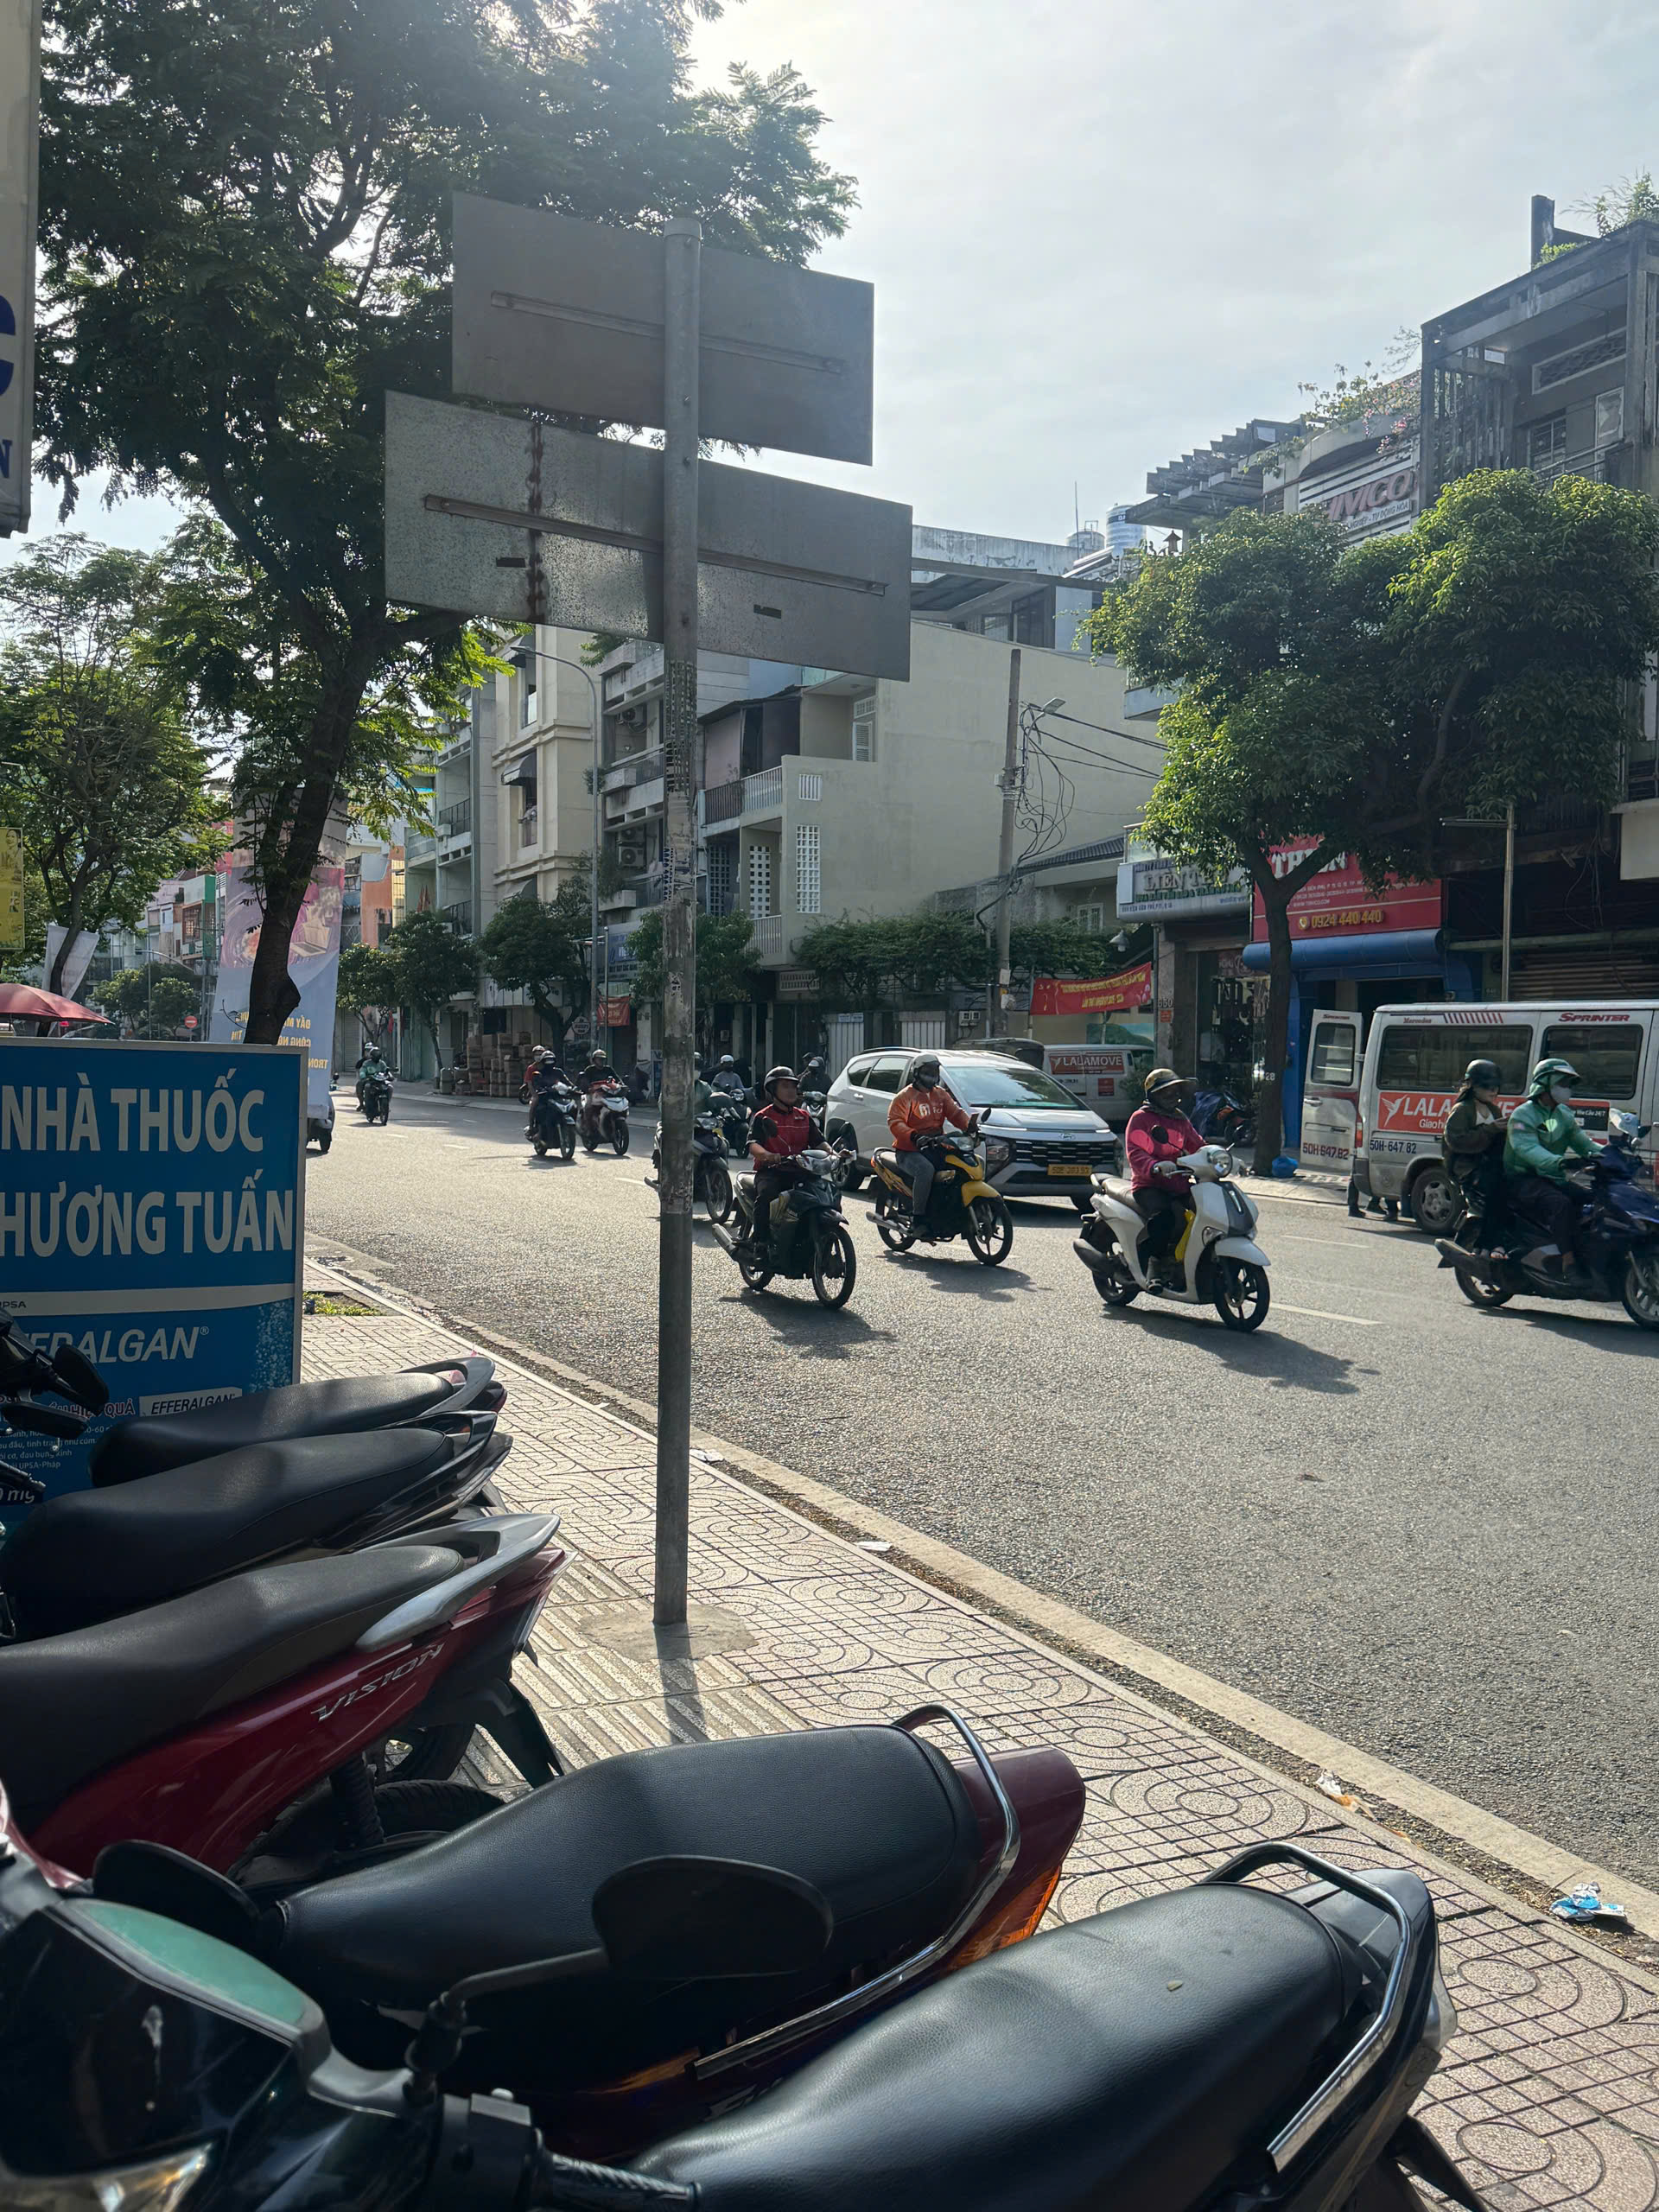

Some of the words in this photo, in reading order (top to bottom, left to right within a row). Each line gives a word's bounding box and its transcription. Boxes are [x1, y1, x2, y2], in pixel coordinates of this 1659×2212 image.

[1311, 915, 1336, 929] 0924
[1338, 912, 1359, 925] 440
[1361, 910, 1382, 924] 440
[1063, 1056, 1122, 1066] LALAMOVE
[1, 1072, 101, 1153] NHÀ
[111, 1068, 265, 1153] THUỐC
[175, 1168, 293, 1255] TUẤN
[0, 1300, 27, 1309] PSA
[104, 1397, 136, 1419] QUẢ
[310, 1641, 447, 1722] VISION
